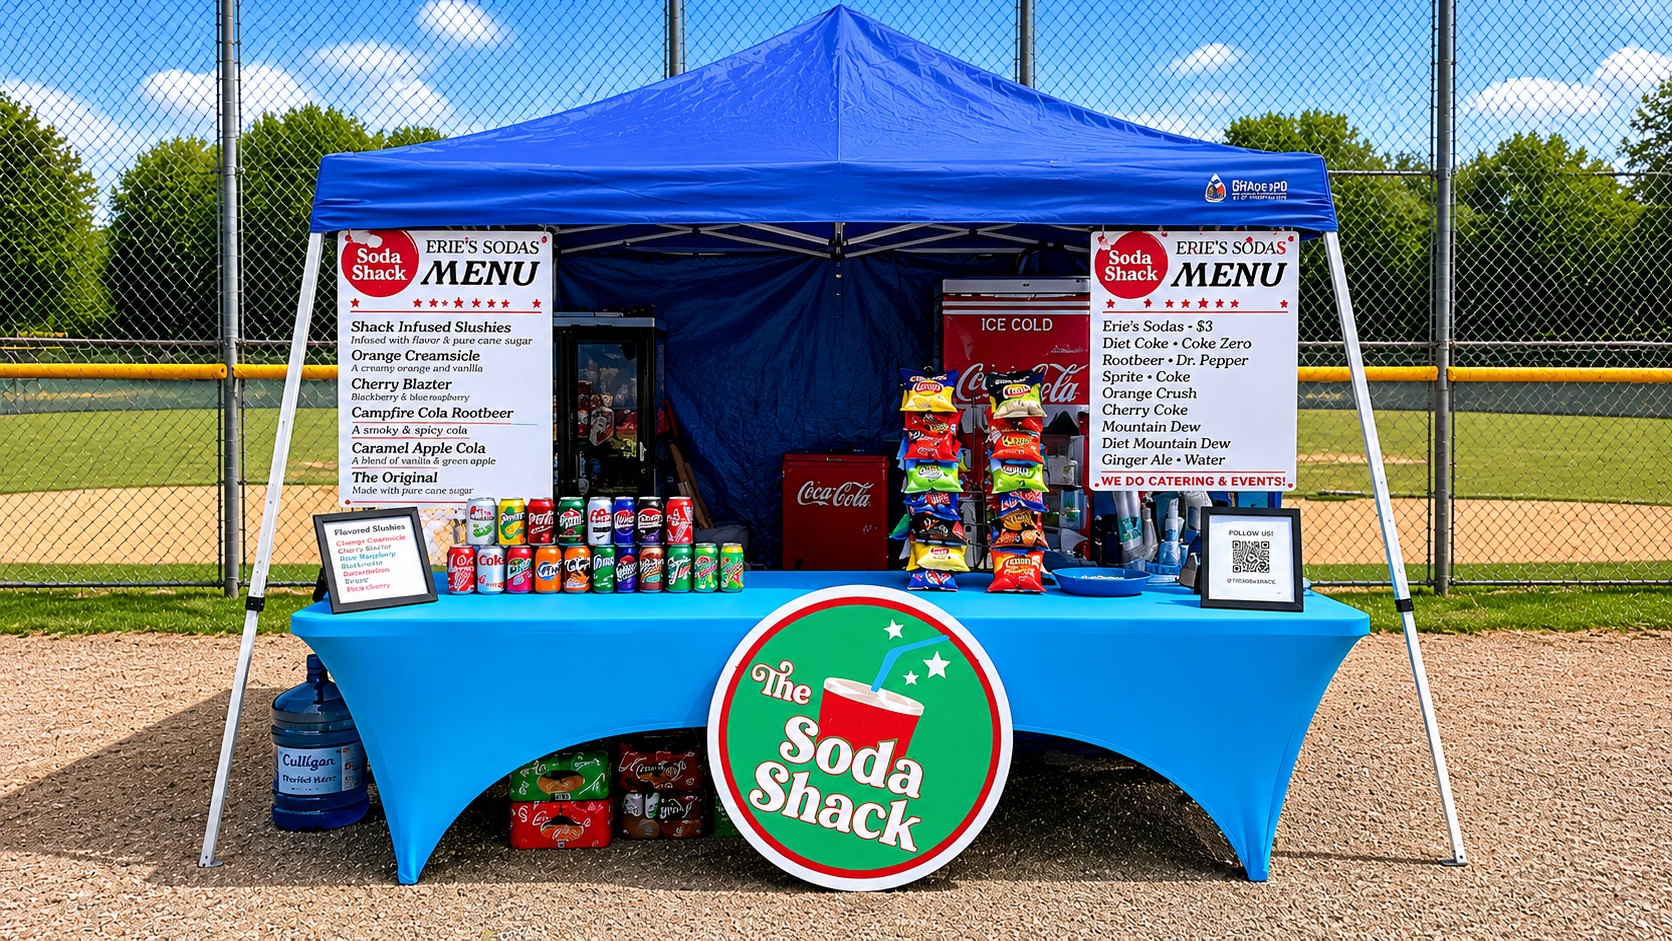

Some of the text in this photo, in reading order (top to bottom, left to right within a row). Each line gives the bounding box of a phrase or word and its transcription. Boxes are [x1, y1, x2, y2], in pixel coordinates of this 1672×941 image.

[426, 240, 539, 254] ERIE'S SODAS
[1176, 241, 1286, 255] ERIE'S SODAS
[357, 248, 402, 264] Soda
[1109, 250, 1152, 265] Soda
[352, 265, 407, 281] Shack
[420, 261, 540, 286] MENU
[1104, 266, 1158, 281] Shack
[1170, 263, 1287, 287] MENU
[351, 321, 511, 333] Shack Infused Slushies
[981, 318, 1052, 331] ICE COLD
[1103, 320, 1139, 332] Erie's
[1143, 320, 1184, 332] Sodas
[1196, 320, 1213, 332] $3
[389, 336, 409, 344] with
[452, 338, 475, 347] pure
[504, 338, 533, 347] sugar
[1103, 337, 1252, 349] Diet Coke Coke Zero
[352, 350, 480, 363] Orange Creamsicle
[1102, 354, 1249, 369] Rootbeer Dr. Pepper
[351, 378, 452, 392] Cherry Blazter
[1102, 371, 1190, 385] Sprite Coke
[1102, 387, 1197, 402] Orange Crush
[352, 407, 514, 420] Campfire Cola Rootbeer
[1102, 404, 1188, 418] Cherry Coke
[351, 426, 467, 437] A smoky & spicy cola
[1102, 421, 1201, 432] Mountain Dew
[352, 442, 486, 456] Caramel Apple Cola
[1102, 438, 1231, 449] Diet Mountain Dew
[362, 457, 387, 465] blend
[389, 457, 400, 465] of
[442, 459, 468, 467] green
[471, 458, 496, 466] apple
[1102, 454, 1225, 468] Ginger Ale Water
[352, 472, 437, 486] The Original
[1101, 476, 1285, 486] WE DO CATERING & EVENTS!
[402, 488, 422, 496] pure
[797, 481, 874, 507] Coca-Cola
[751, 660, 812, 705] The
[283, 754, 335, 771] Culligan
[779, 715, 924, 799] Soda
[748, 760, 922, 853] Shack
